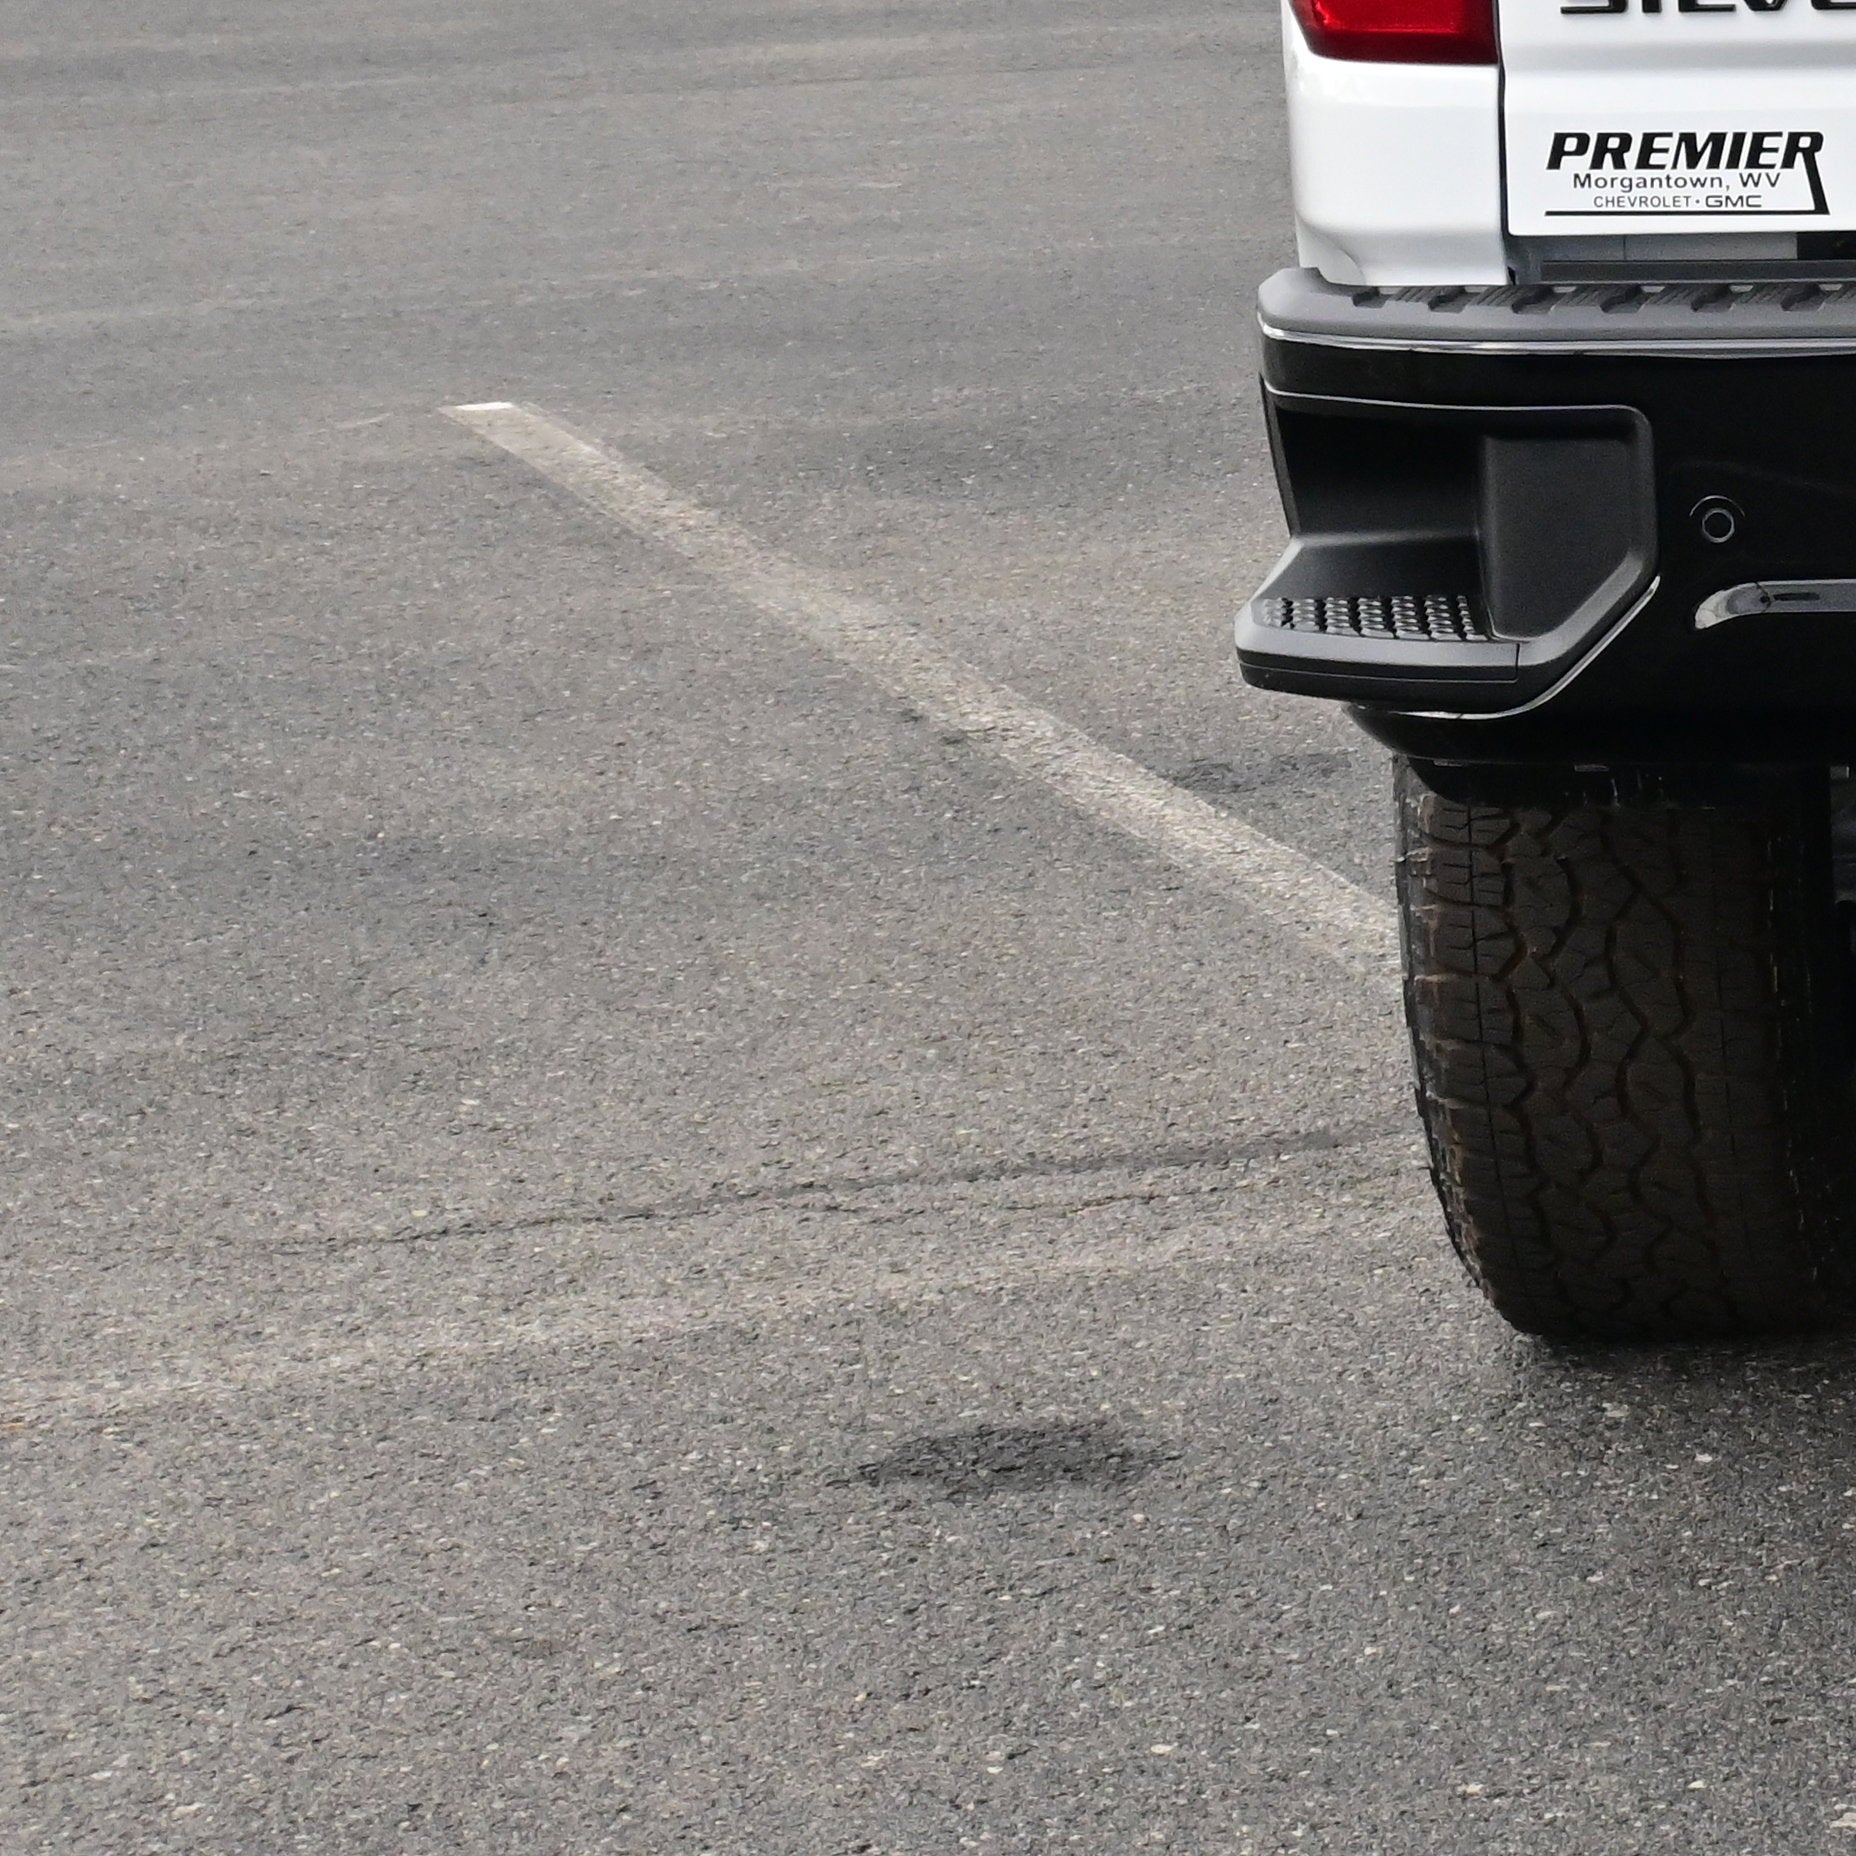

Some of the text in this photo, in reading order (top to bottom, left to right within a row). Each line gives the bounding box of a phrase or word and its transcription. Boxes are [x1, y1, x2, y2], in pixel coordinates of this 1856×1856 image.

[1546, 132, 1824, 170] PREMIER
[1573, 172, 1781, 193] Morgantown, WV
[1594, 195, 1762, 208] CHEVROLET GMC
